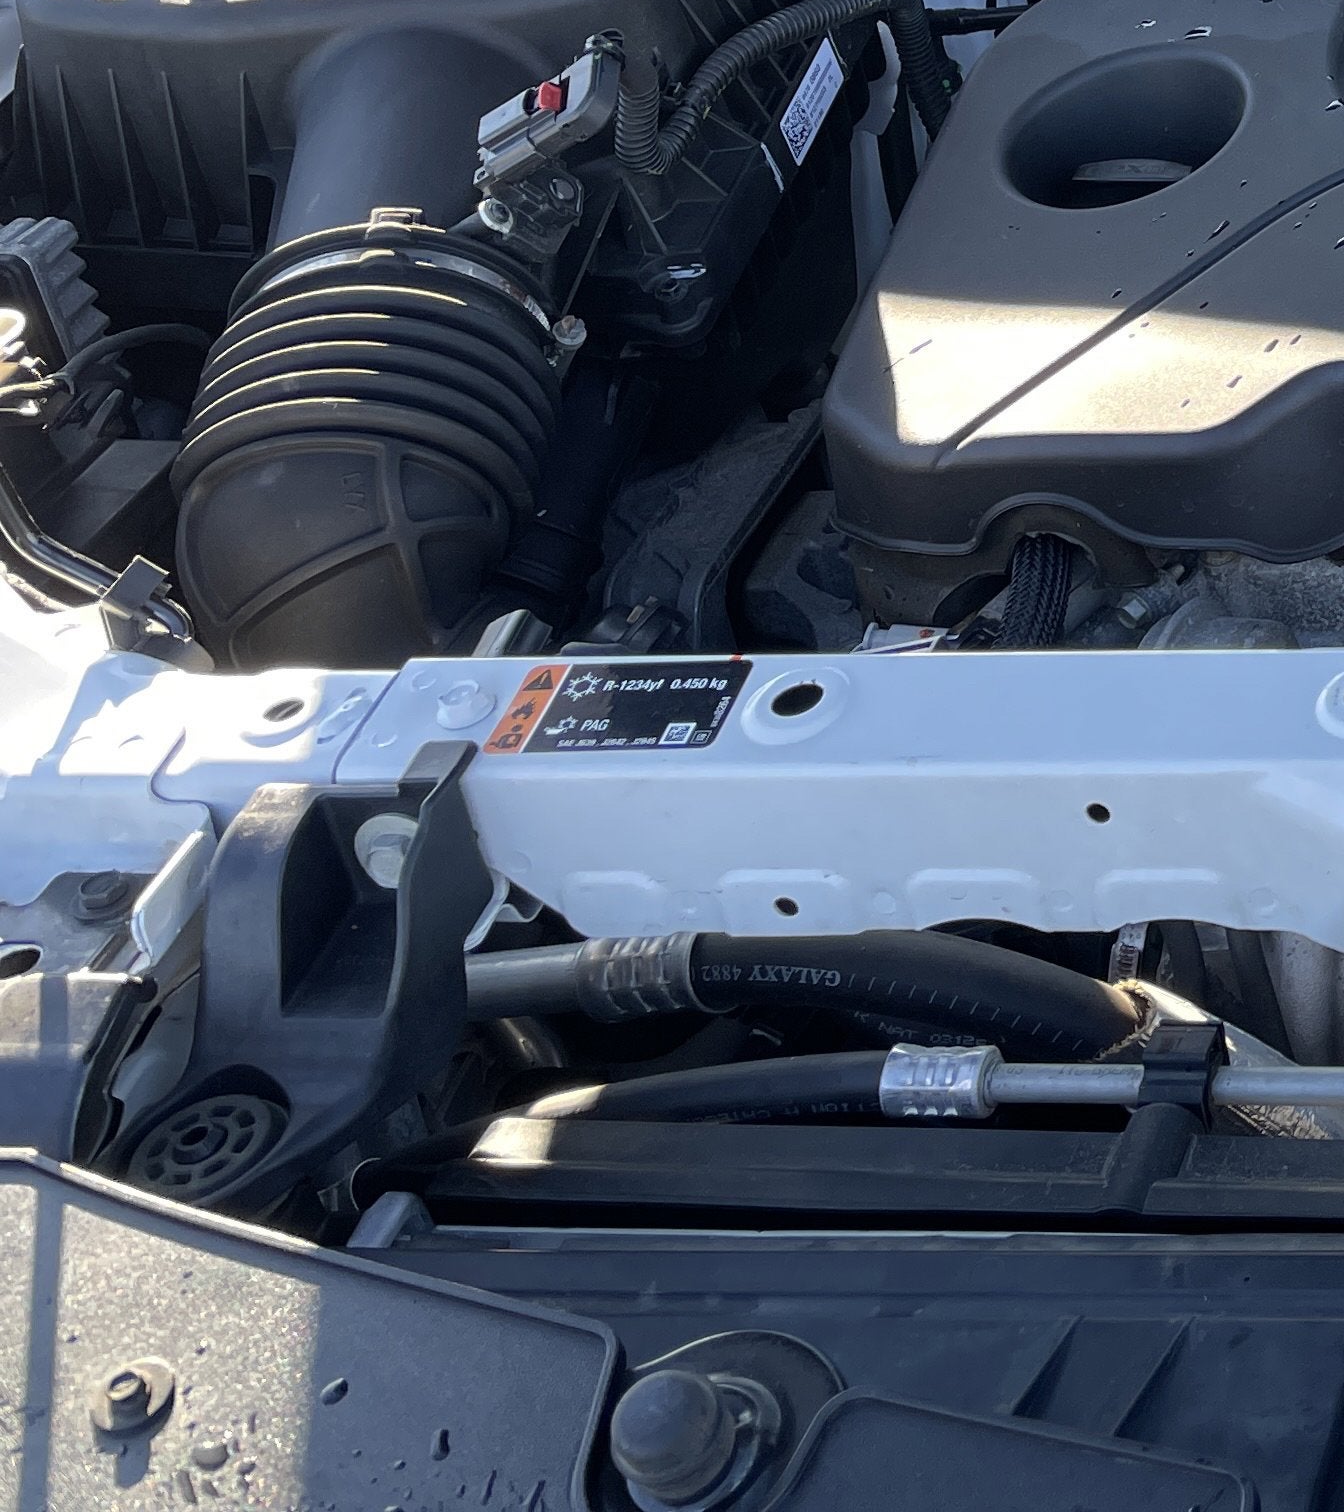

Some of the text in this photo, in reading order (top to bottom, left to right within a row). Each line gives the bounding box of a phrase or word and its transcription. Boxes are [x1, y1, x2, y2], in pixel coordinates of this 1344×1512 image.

[603, 677, 728, 693] R-1234yf 0.450 kg
[580, 718, 611, 731] PAG
[702, 964, 841, 987] GALAXY 4882
